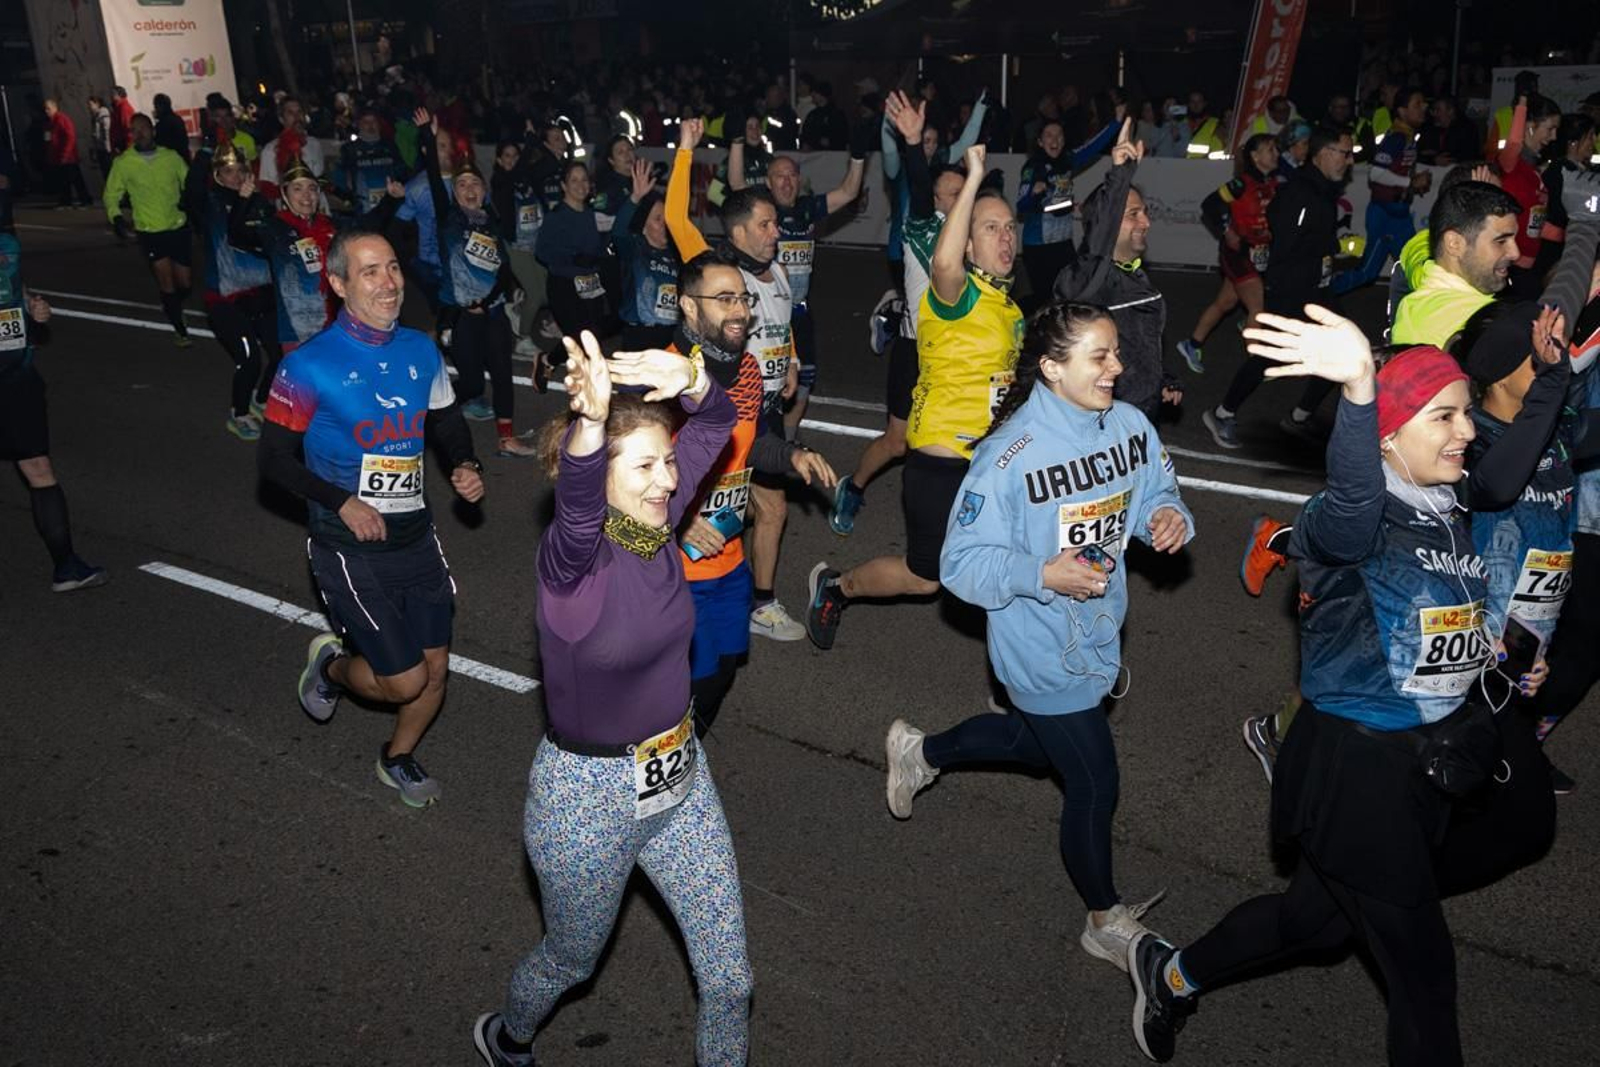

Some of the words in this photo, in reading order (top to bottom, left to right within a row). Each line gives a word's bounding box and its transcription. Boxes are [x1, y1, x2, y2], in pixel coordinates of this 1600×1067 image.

[133, 19, 197, 31] calderón
[782, 251, 811, 262] 6196
[0, 320, 21, 336] 38
[383, 440, 412, 453] SPORT
[996, 434, 1033, 470] Kappa
[1025, 432, 1148, 504] URUGUAY
[368, 470, 420, 492] 6748
[705, 485, 747, 510] 10172
[1081, 504, 1097, 517] 42
[1068, 508, 1127, 546] 6129
[1443, 611, 1459, 627] 42
